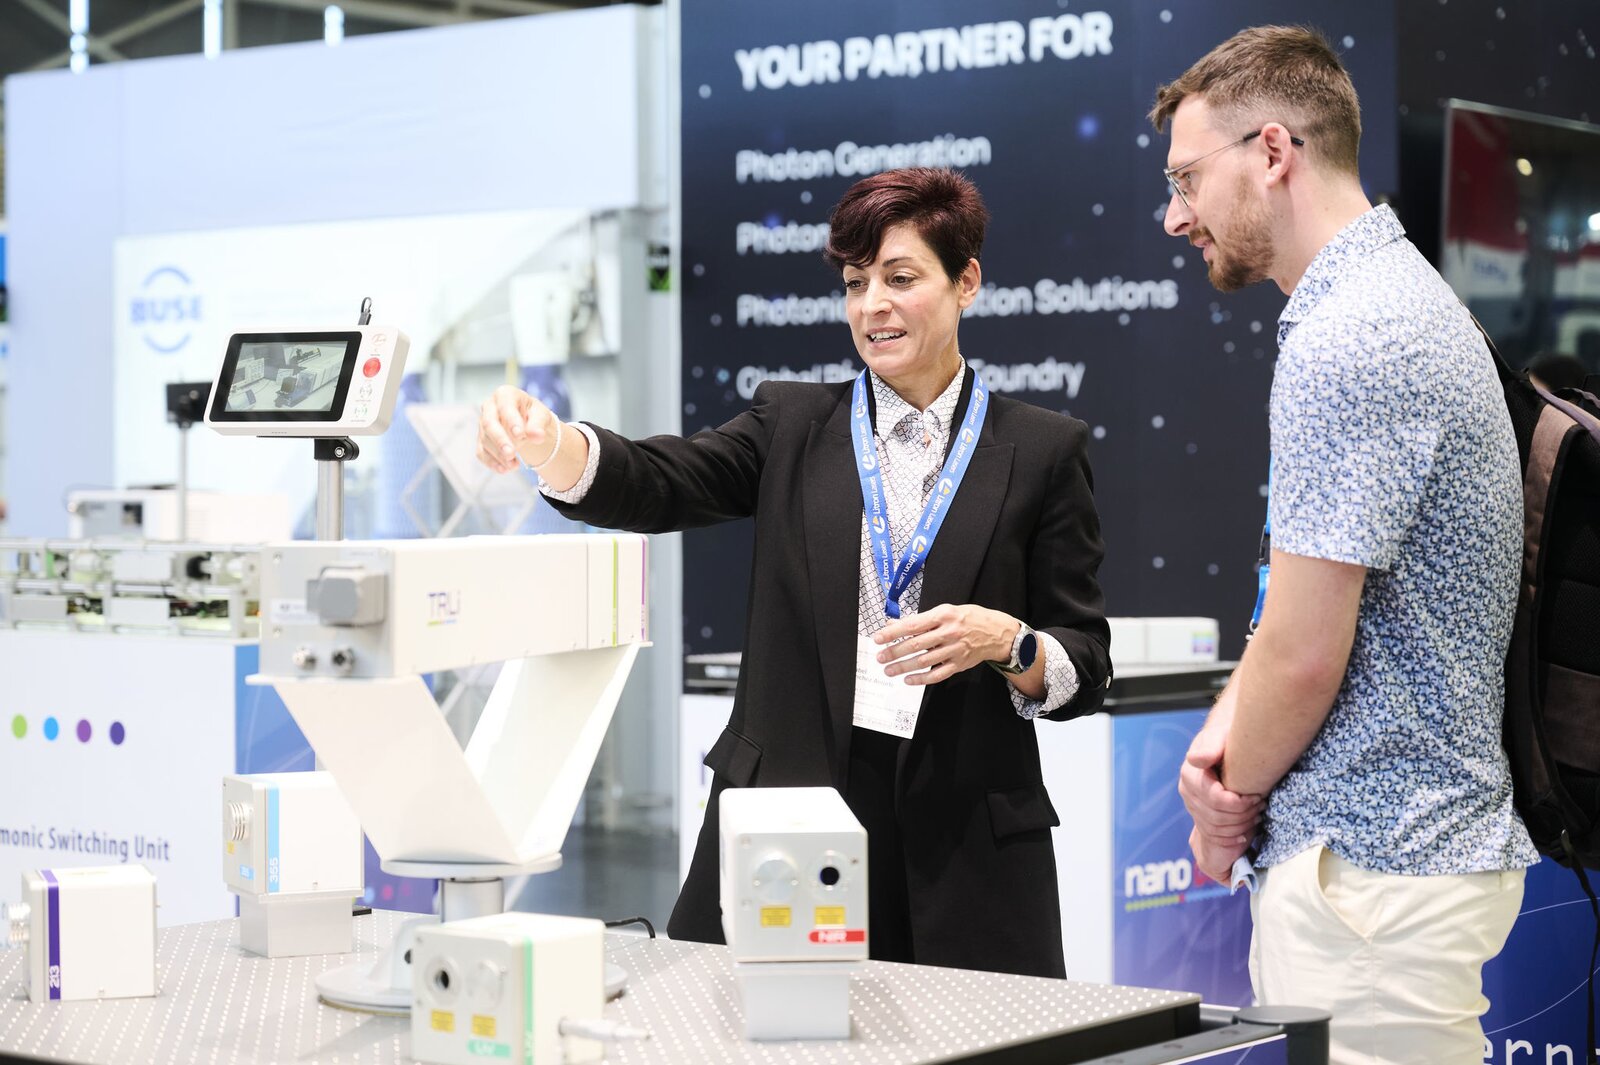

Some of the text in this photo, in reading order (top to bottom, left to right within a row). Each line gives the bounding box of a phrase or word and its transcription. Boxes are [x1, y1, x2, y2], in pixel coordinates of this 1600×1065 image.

[735, 10, 1113, 91] YOUR PARTNER FOR
[736, 133, 992, 183] Photon Generation
[131, 296, 204, 326] BUSE
[1034, 275, 1180, 314] Solutions
[862, 438, 870, 454] Litron
[956, 443, 968, 460] Litron
[870, 476, 878, 494] Lasers
[924, 494, 944, 530] Litron Lasers
[880, 540, 890, 580] Litron Lasers
[895, 552, 919, 590] Litron Lasers
[49, 827, 128, 863] Switching
[134, 835, 170, 861] Unit
[269, 856, 279, 882] 355
[1124, 858, 1193, 898] nano
